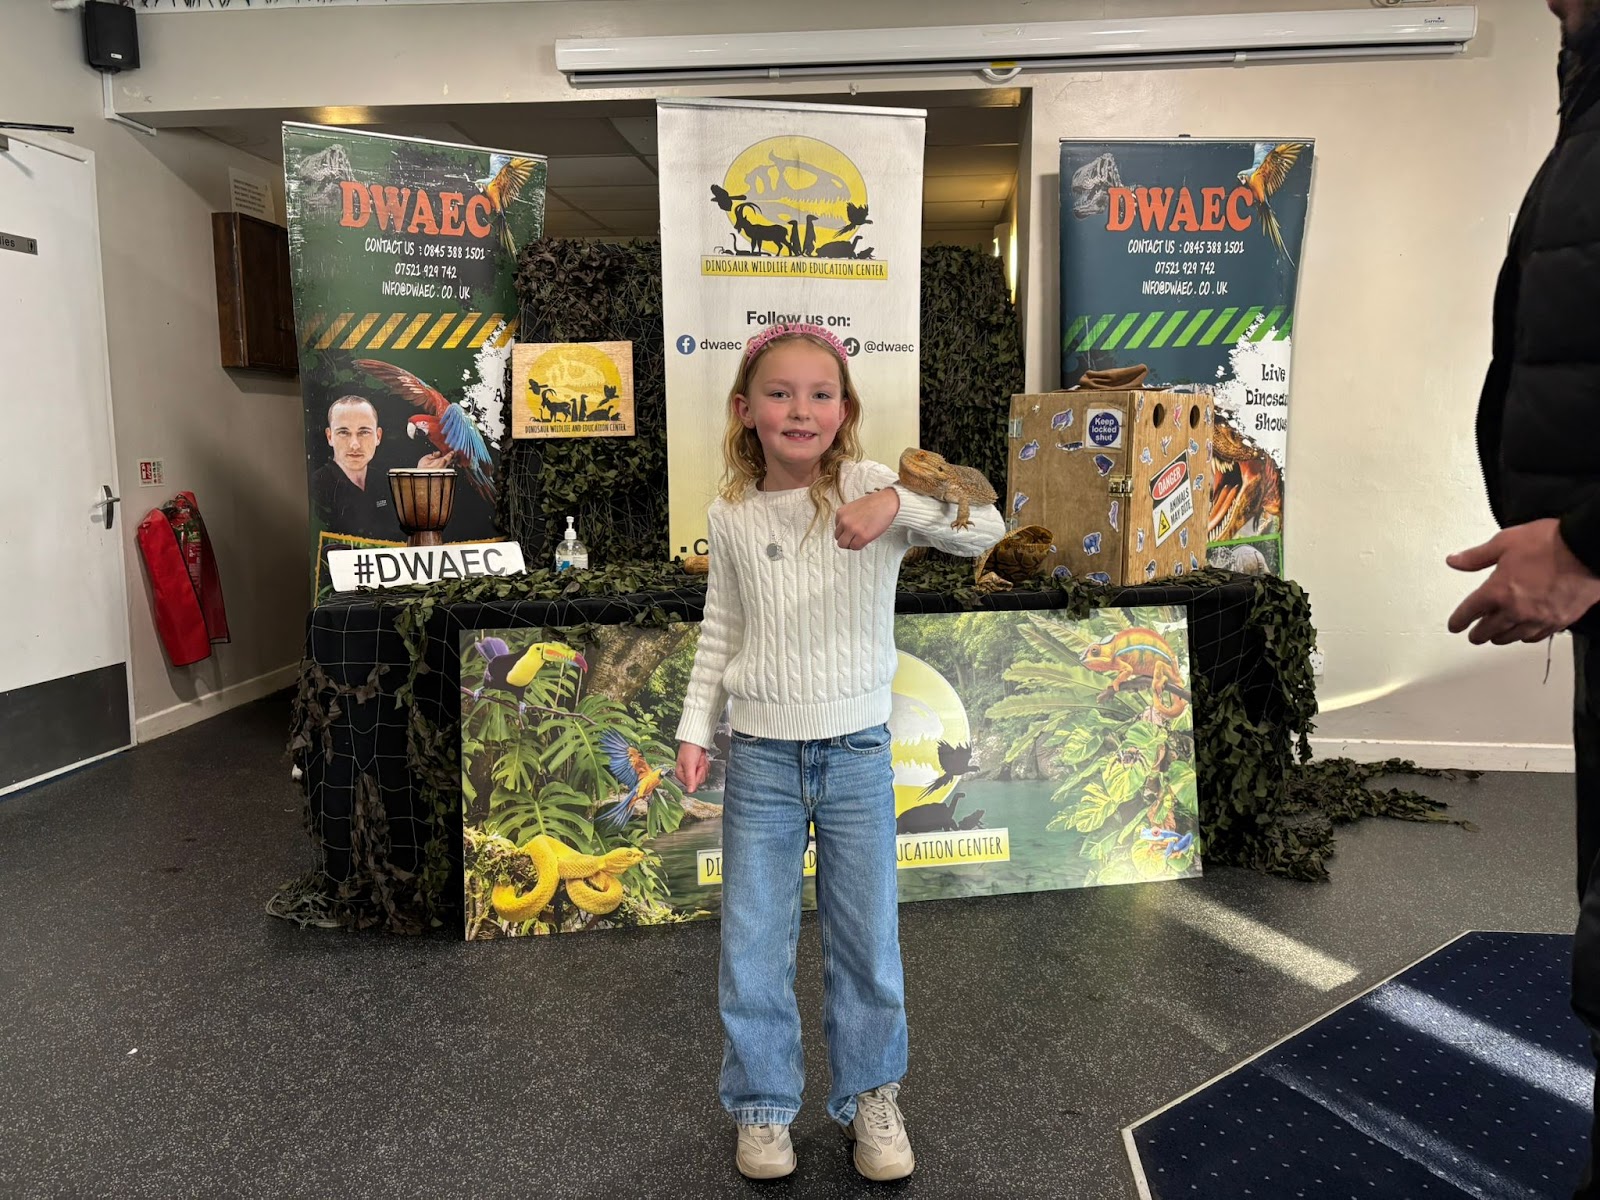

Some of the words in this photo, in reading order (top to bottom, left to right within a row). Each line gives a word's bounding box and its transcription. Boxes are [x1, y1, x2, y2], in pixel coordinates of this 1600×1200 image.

[340, 181, 491, 238] DWAEC
[1106, 186, 1254, 232] DWAEC
[0, 235, 16, 248] ies
[365, 237, 402, 254] CONTACT
[404, 241, 414, 256] US
[447, 245, 462, 258] 388
[465, 246, 485, 260] 1501
[1127, 239, 1163, 254] CONTACT
[1165, 240, 1175, 254] US
[1206, 241, 1221, 254] 388
[1224, 241, 1244, 254] 1501
[395, 262, 421, 276] 07521
[424, 264, 439, 278] 929
[441, 265, 457, 279] 742
[705, 260, 749, 273] DINOSAUR
[751, 262, 788, 274] WILDLIFE
[790, 262, 807, 274] AND
[809, 262, 854, 276] EDUCATION
[856, 264, 884, 276] CENTER
[1155, 261, 1180, 275] 07521
[1182, 262, 1197, 275] 929
[1200, 261, 1215, 275] 742
[746, 311, 801, 325] Follow
[806, 315, 823, 326] us
[828, 315, 850, 327] on:
[700, 339, 742, 350] dwaec
[864, 341, 914, 353] @dwaec
[1261, 363, 1286, 382] Live
[1091, 425, 1117, 433] locked
[1094, 417, 1115, 426] Keep
[1095, 433, 1113, 441] shut
[1157, 466, 1182, 496] DANGER
[1169, 487, 1190, 513] ANIMALS
[1170, 510, 1181, 525] MAY
[354, 548, 505, 583] #DWAEC
[896, 839, 954, 862] UCATION
[958, 836, 1003, 857] CENTER
